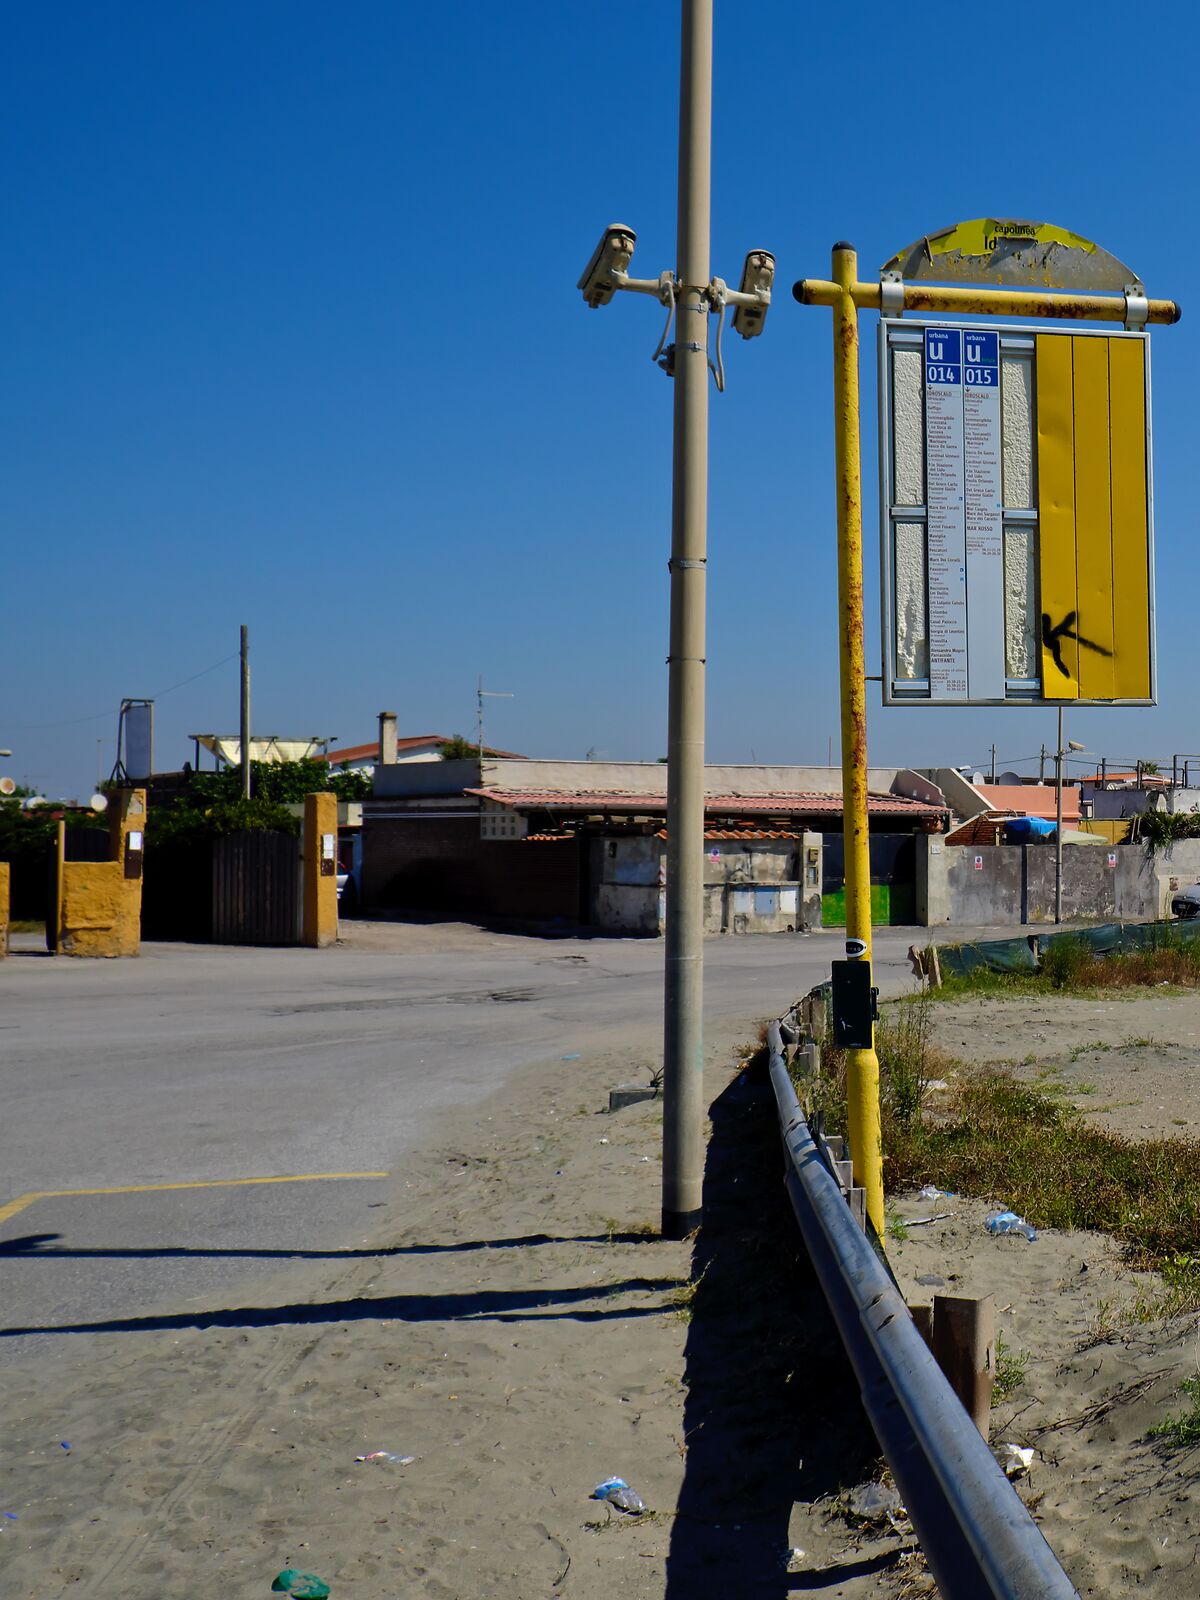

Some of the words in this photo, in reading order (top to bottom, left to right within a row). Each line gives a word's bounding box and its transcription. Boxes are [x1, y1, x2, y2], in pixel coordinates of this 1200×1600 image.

[995, 224, 1036, 236] capolinea
[928, 366, 955, 382] 014
[966, 368, 992, 384] 015
